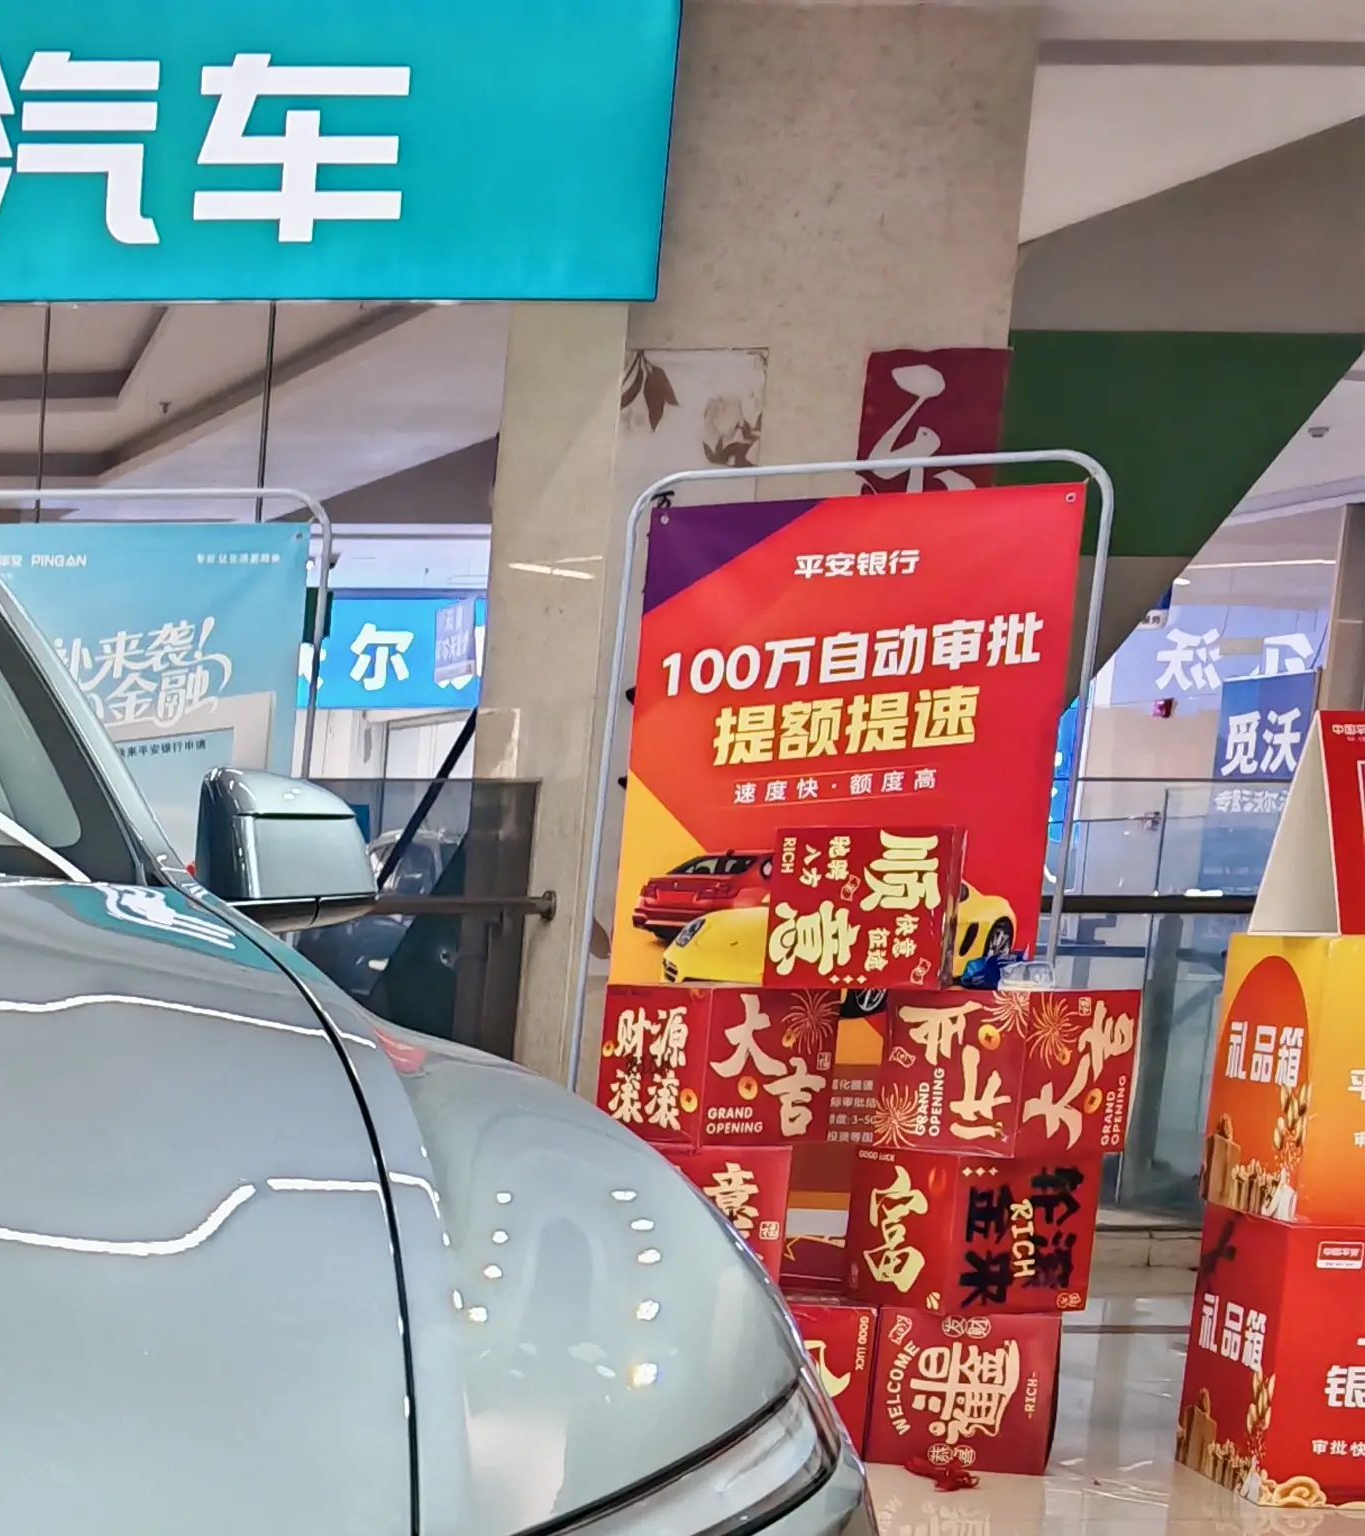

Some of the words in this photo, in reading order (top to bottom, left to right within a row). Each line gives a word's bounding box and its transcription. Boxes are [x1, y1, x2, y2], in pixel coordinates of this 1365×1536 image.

[794, 548, 921, 579] 平安银行
[660, 611, 1044, 696] 100万自动审批
[712, 685, 981, 767] 提额提速
[780, 837, 797, 874] RICH
[859, 829, 942, 912] 顺
[769, 900, 861, 976] 意
[1225, 1021, 1305, 1088] 礼品箱
[706, 1121, 764, 1135] OPENING
[707, 1107, 754, 1120] GRAND
[914, 1081, 931, 1137] GRAND
[928, 1067, 946, 1138] OPENING
[1100, 1090, 1116, 1146] GRAND
[1111, 1074, 1127, 1146] OPENING
[863, 1165, 929, 1293] 富
[1010, 1199, 1036, 1279] RICH
[854, 1346, 868, 1372] LUCK
[857, 1315, 870, 1345] GOOD
[1198, 1292, 1268, 1373] 礼品箱
[885, 1340, 921, 1436] WELCOME
